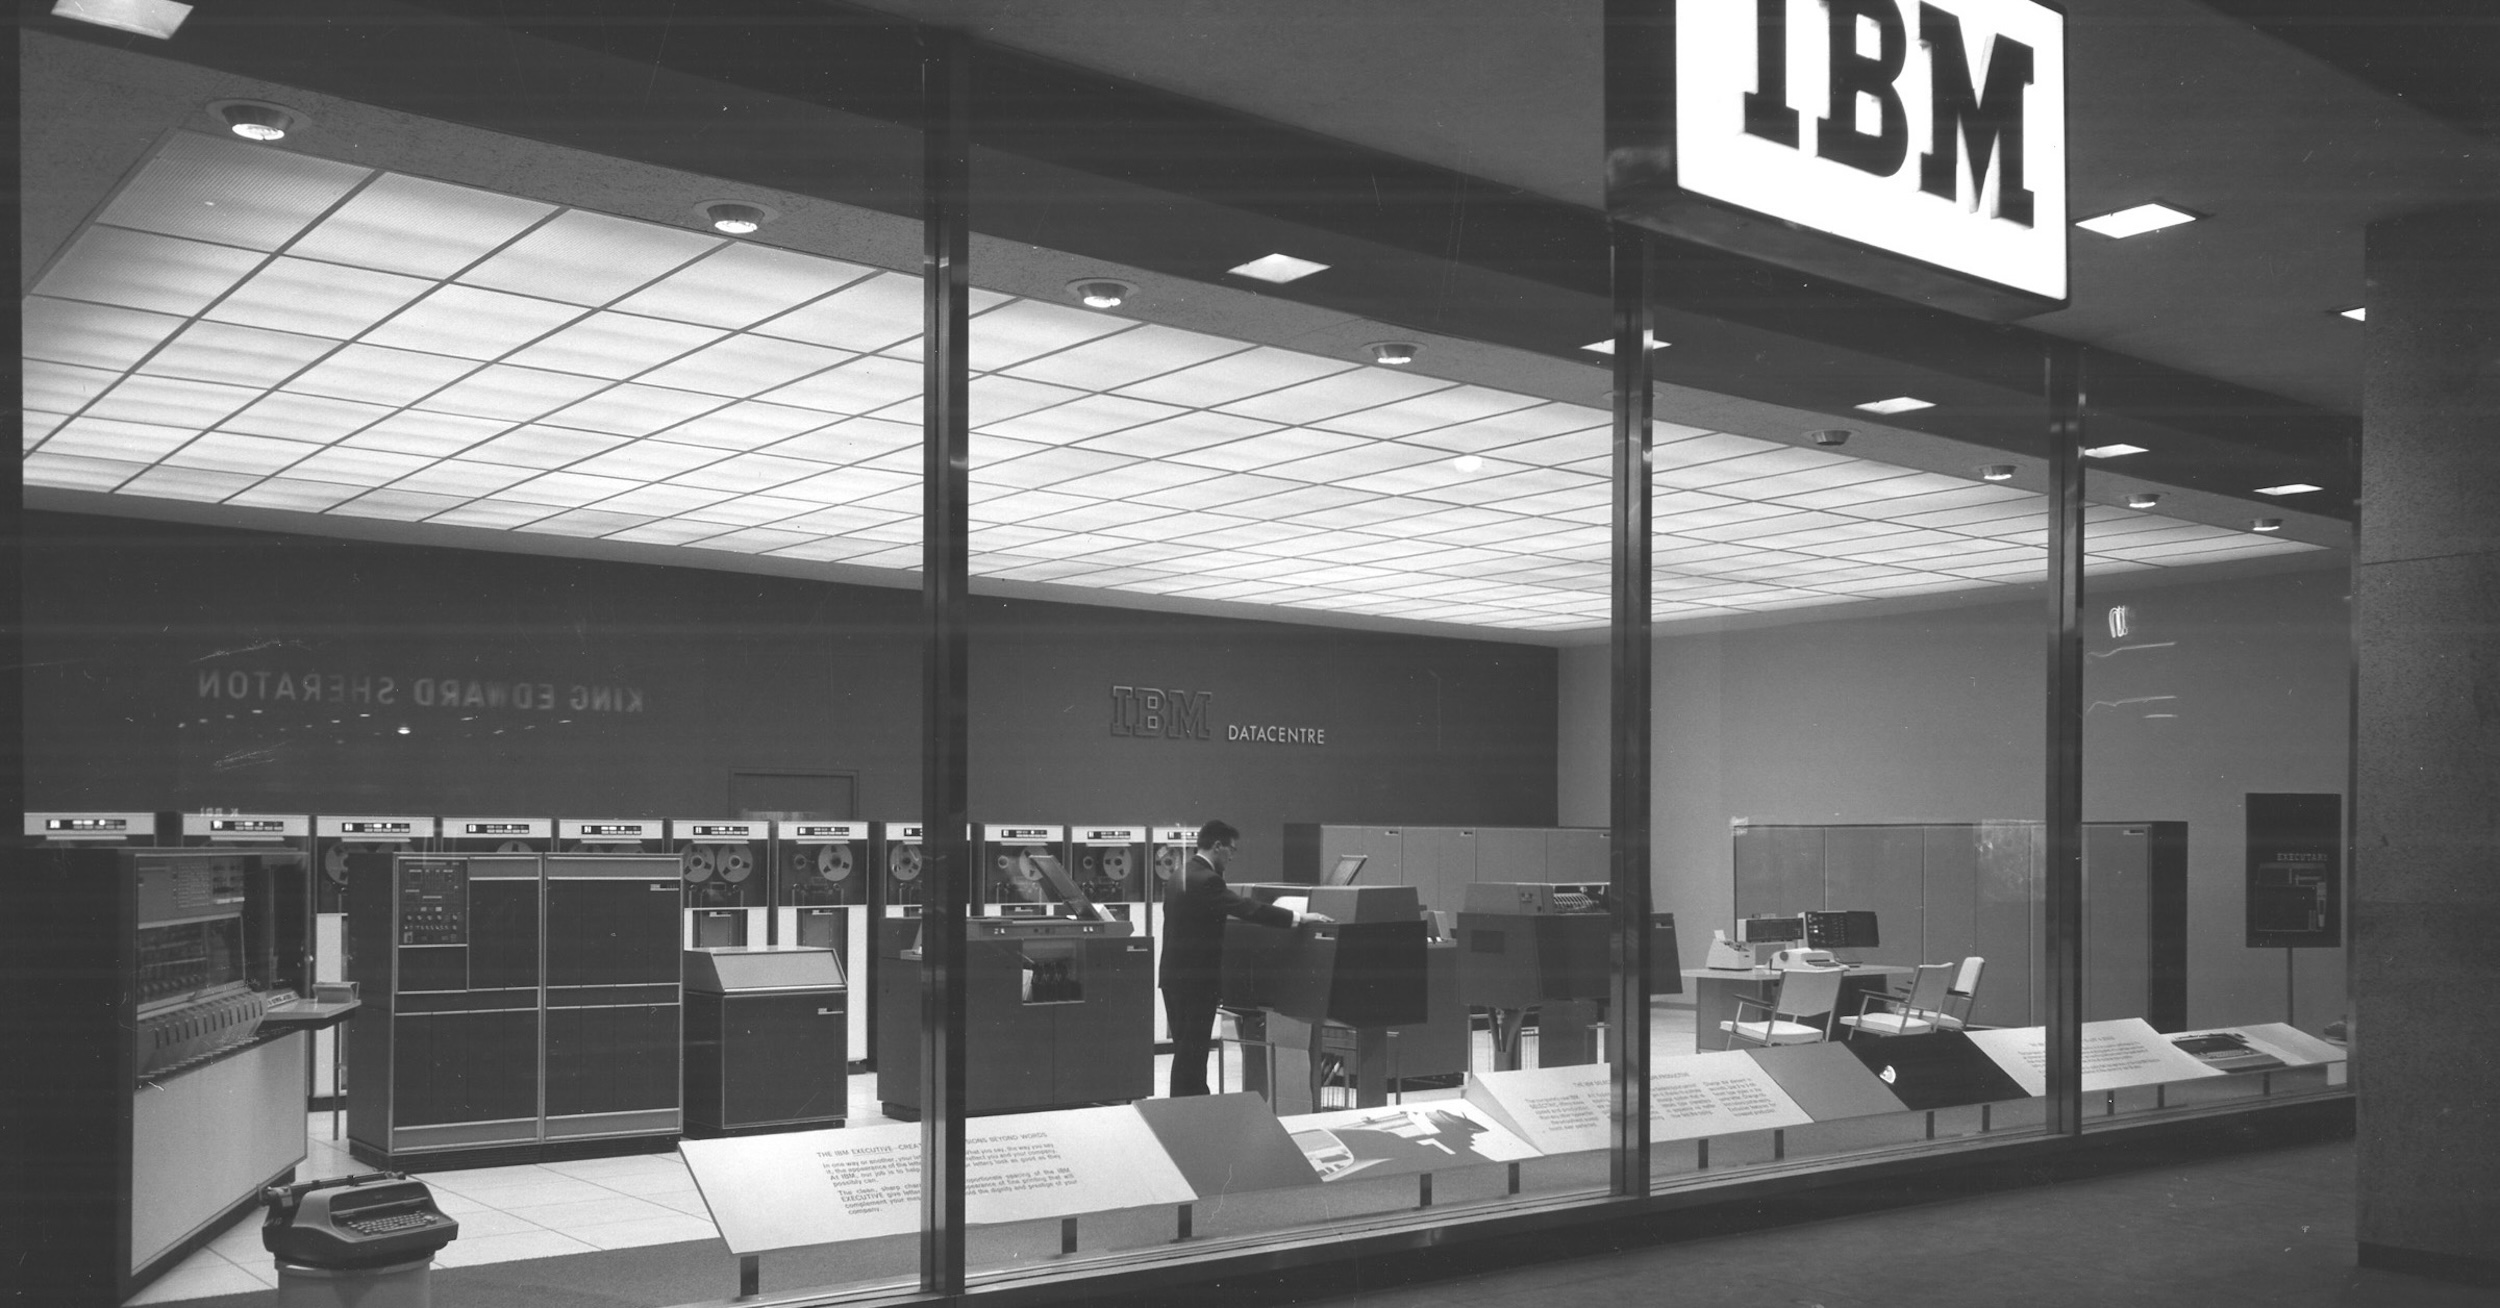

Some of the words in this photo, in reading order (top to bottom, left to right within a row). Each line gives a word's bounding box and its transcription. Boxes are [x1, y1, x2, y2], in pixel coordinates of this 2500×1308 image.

[1743, 0, 2034, 229] IBM
[1110, 685, 1213, 740] IBM
[1228, 725, 1325, 744] DATACENTRE
[851, 1146, 892, 1156] EXECUTIVE
[848, 1164, 887, 1173] appearance
[841, 1192, 883, 1202] EXECUTIVE
[844, 1199, 888, 1209] complement
